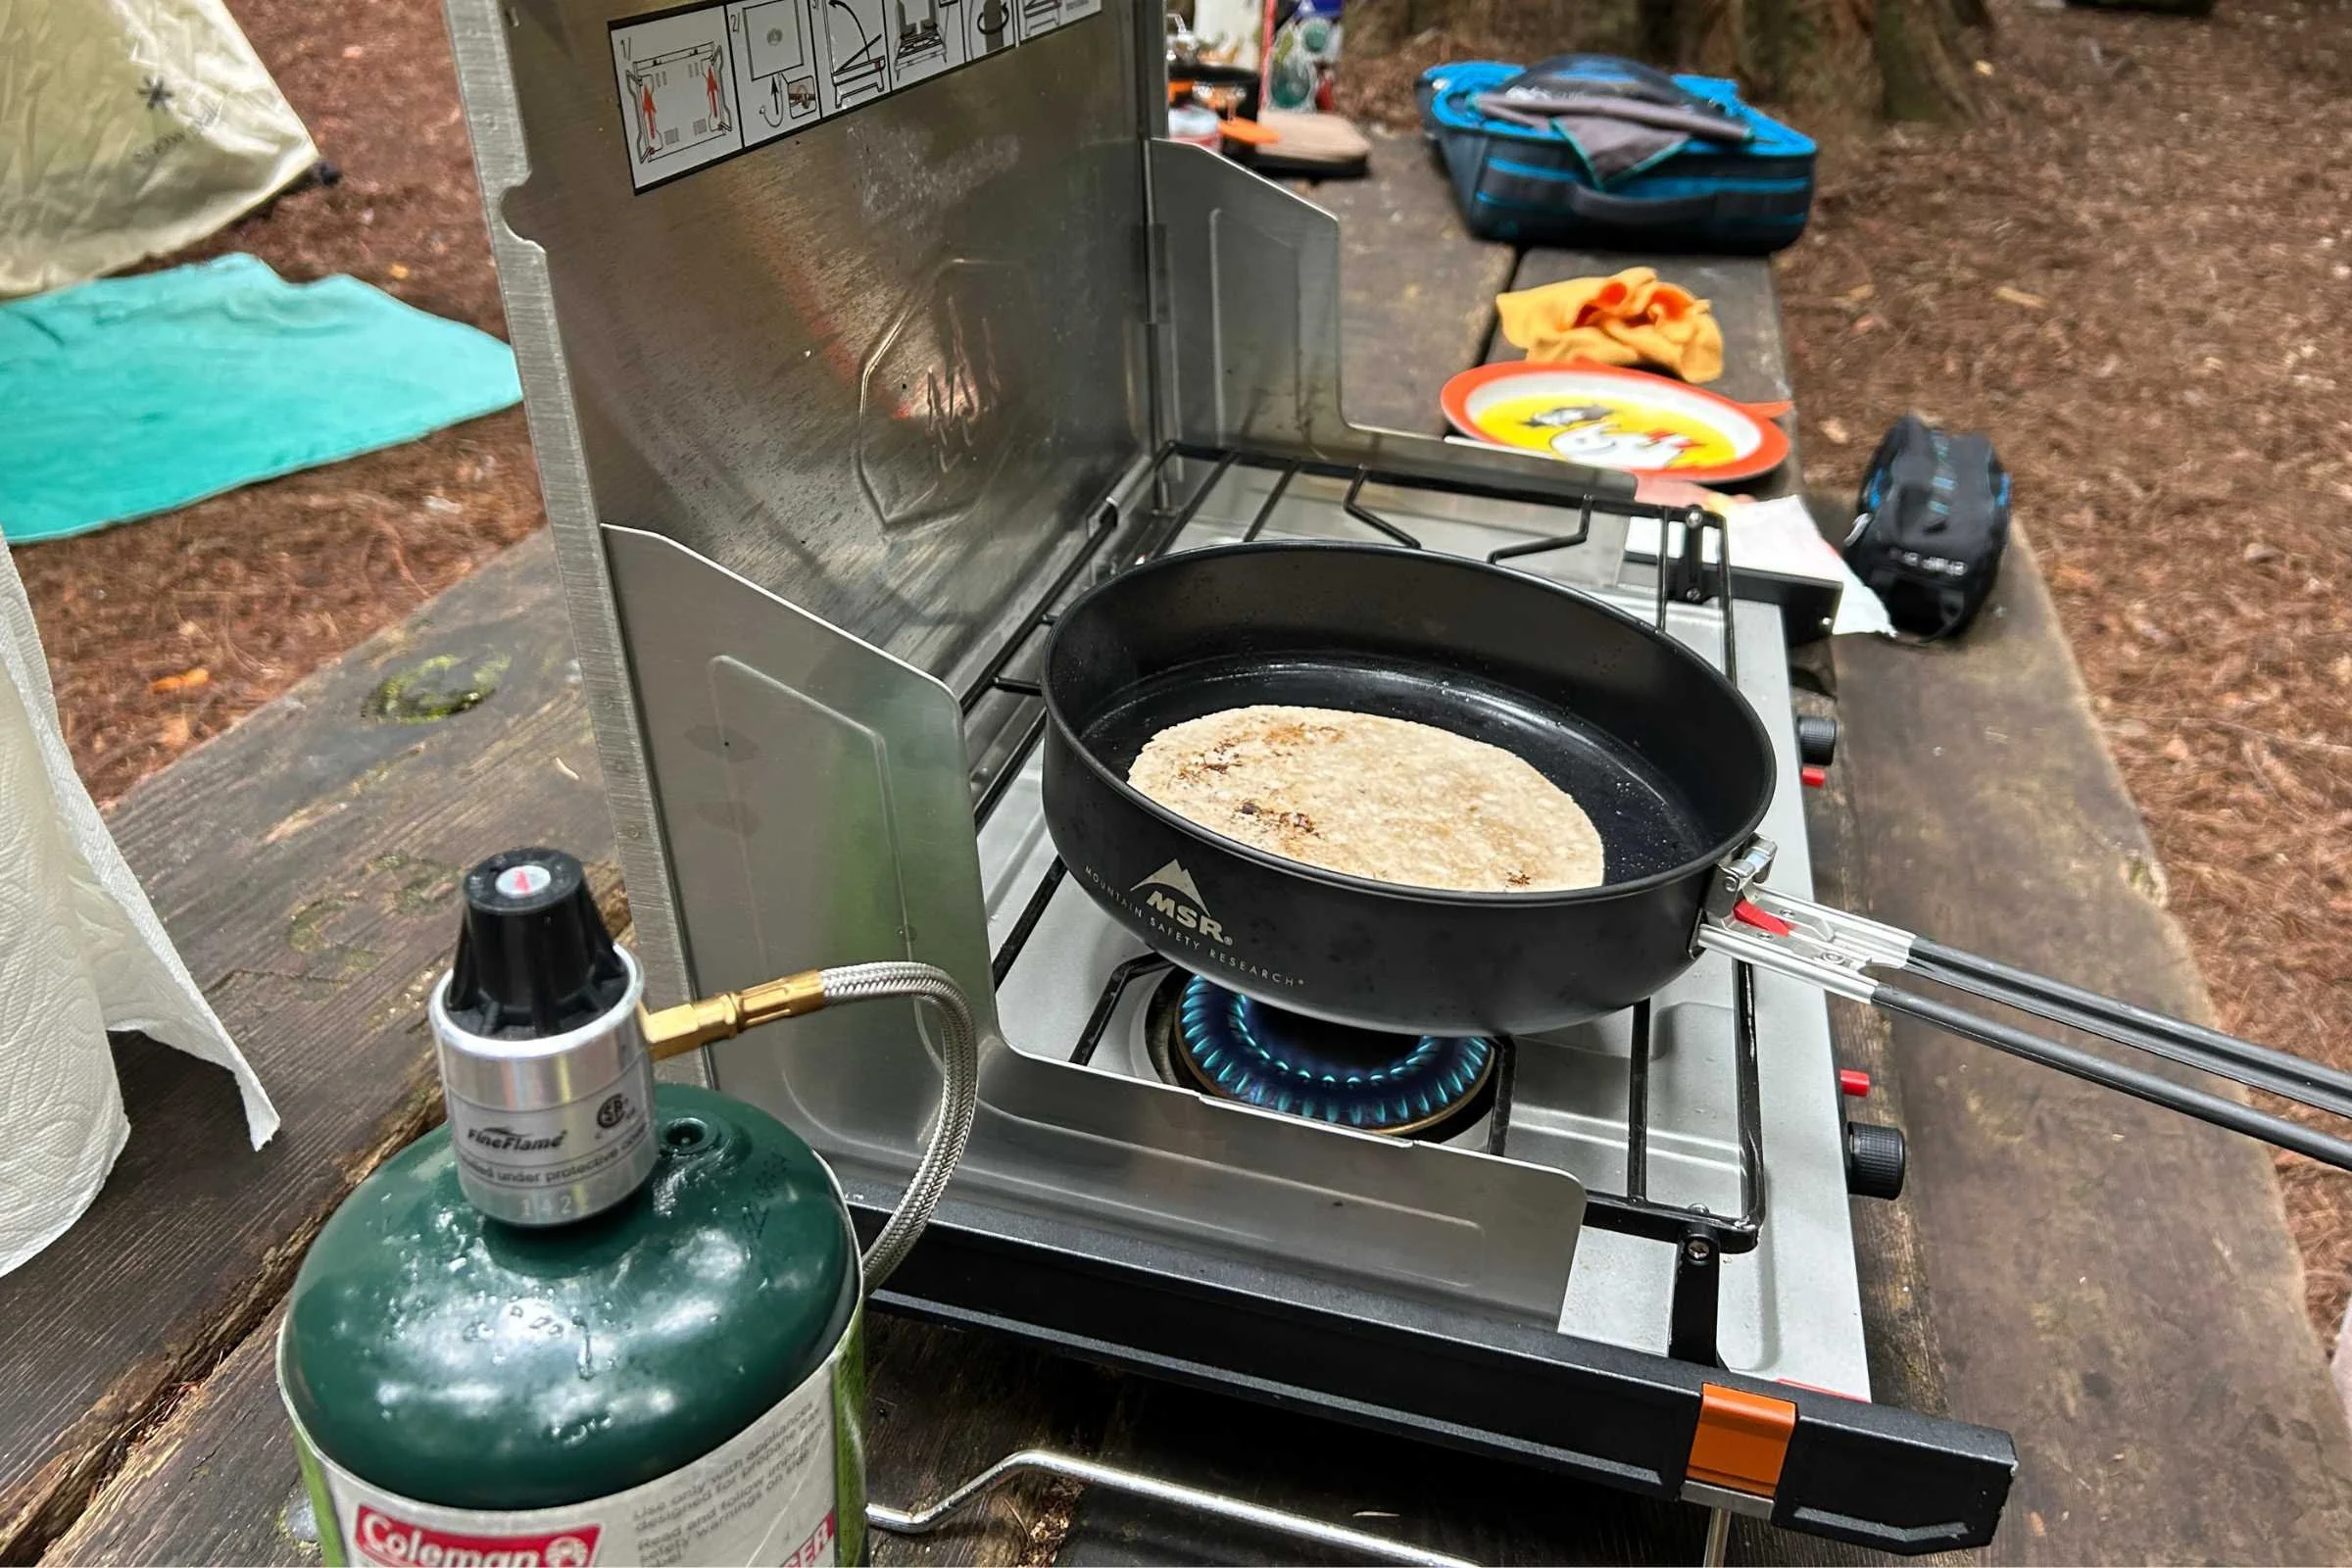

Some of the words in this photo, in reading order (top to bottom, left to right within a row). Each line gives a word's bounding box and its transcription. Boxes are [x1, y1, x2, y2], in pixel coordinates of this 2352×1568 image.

[1084, 865, 1143, 918] MOUNTAIN
[1150, 917, 1200, 950] SAFETY
[1209, 948, 1295, 987] RESEARCH
[467, 1128, 563, 1151] FineFlame
[362, 1513, 543, 1568] Coleman
